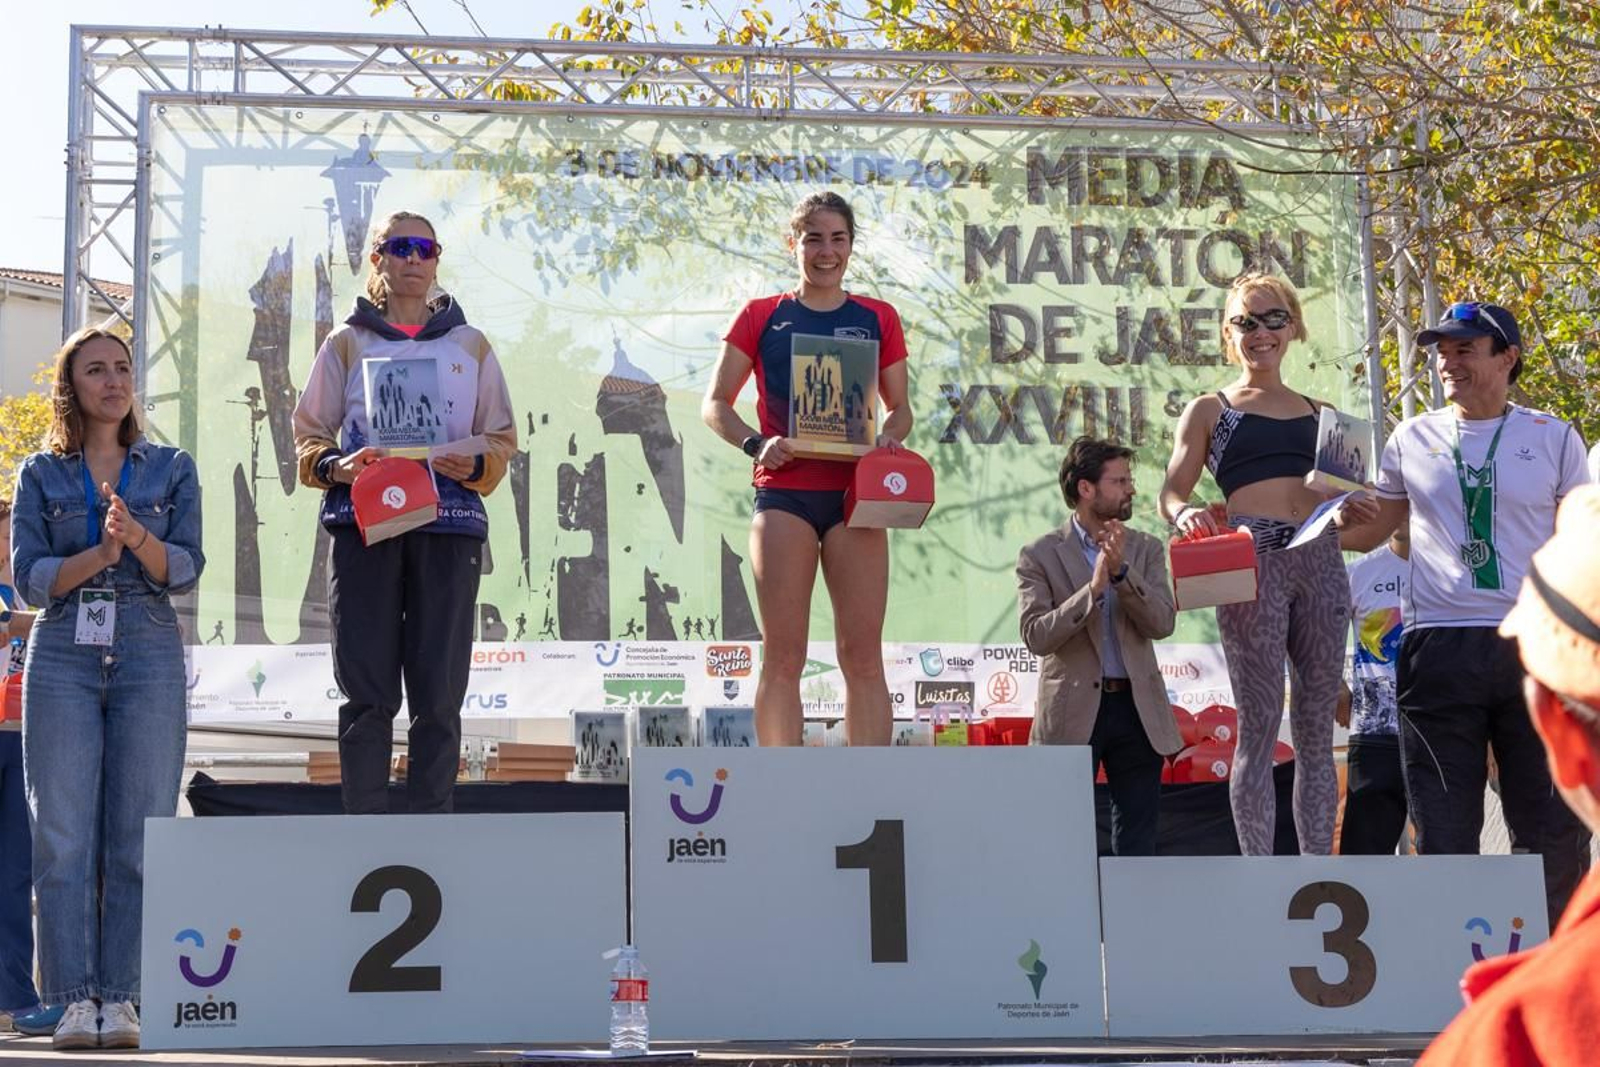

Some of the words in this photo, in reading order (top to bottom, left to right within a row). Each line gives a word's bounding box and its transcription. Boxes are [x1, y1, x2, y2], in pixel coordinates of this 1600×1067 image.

[565, 149, 588, 177] 3
[598, 150, 640, 179] DE
[652, 152, 843, 183] NOVIEMBRE
[853, 154, 895, 185] DE
[904, 157, 992, 189] 2024
[1026, 145, 1244, 209] MEDIA
[963, 209, 1311, 288] MARATÓN
[989, 303, 1079, 365] DE
[938, 384, 1143, 445] XXVIII
[473, 648, 526, 663] erón
[706, 647, 749, 666] Santo
[714, 659, 752, 677] Reino
[946, 655, 975, 667] clibo
[1008, 660, 1038, 673] ADE
[917, 683, 971, 705] Luisitas
[835, 819, 908, 963] 1
[349, 865, 443, 993] 2
[1287, 880, 1378, 1008] 3
